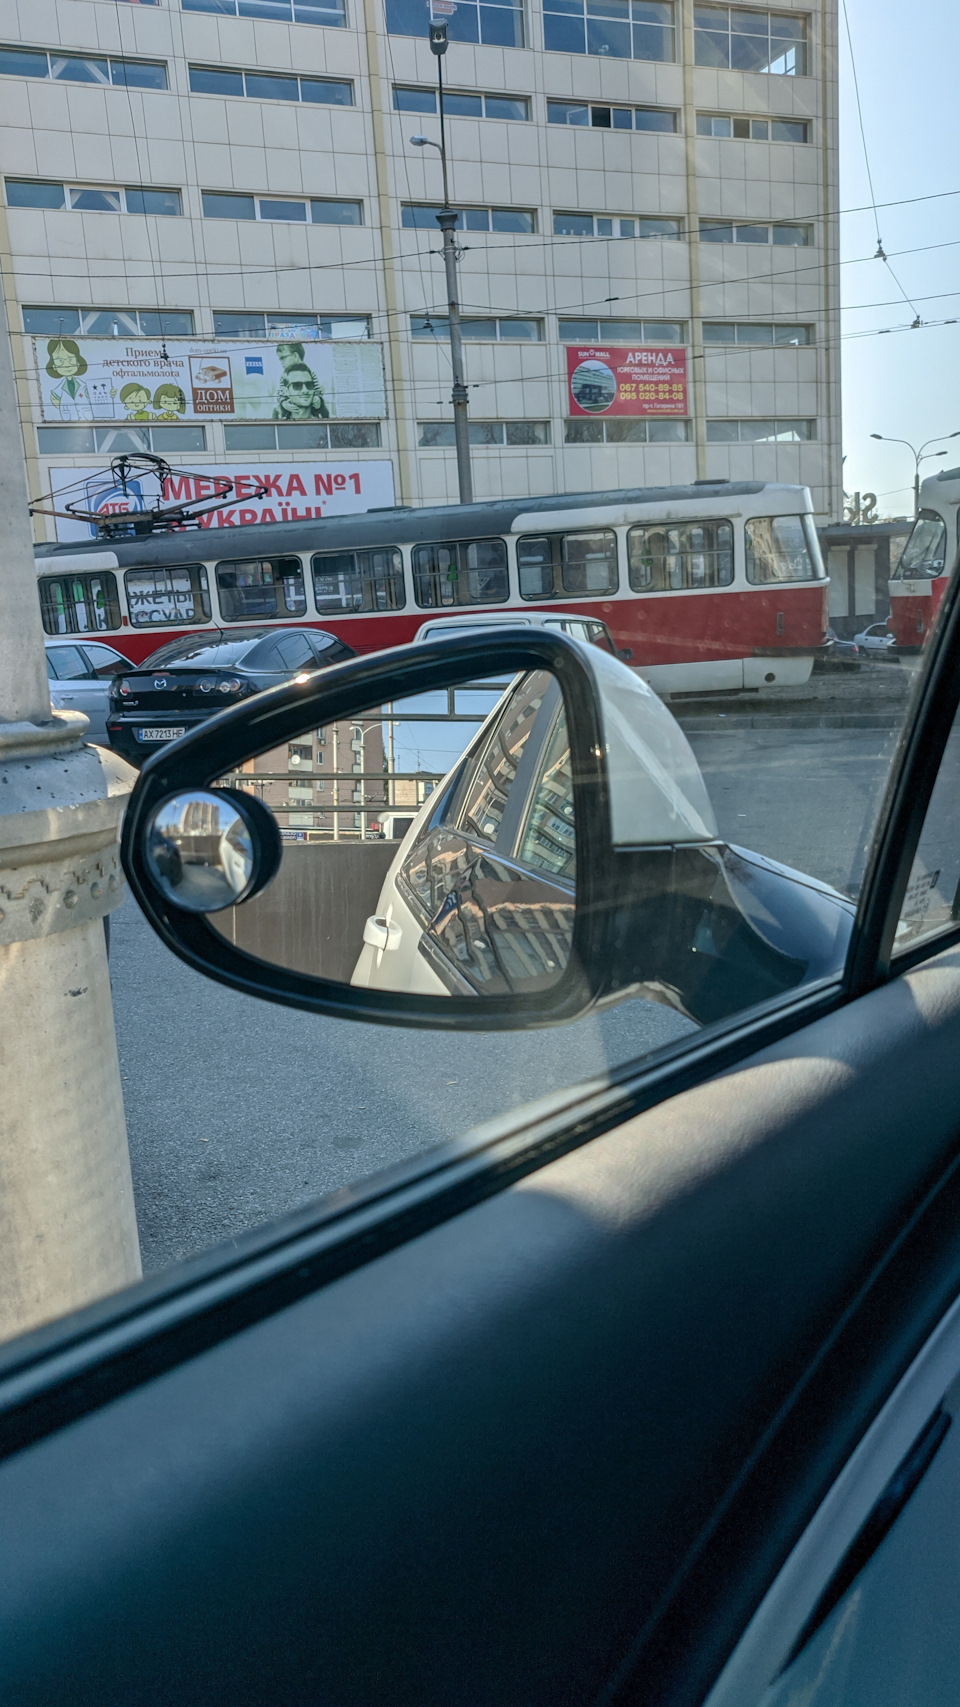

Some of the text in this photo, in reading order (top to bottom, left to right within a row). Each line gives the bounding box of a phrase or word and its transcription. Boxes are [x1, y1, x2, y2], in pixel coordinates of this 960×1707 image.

[125, 347, 162, 359] Прием
[102, 358, 185, 369] детского врача
[625, 352, 675, 366] АРЕНДА
[112, 367, 181, 378] офтальмолога
[616, 366, 648, 374] ТОРГОВЫХ
[631, 373, 671, 381] ПОМЕЩЕНИЙ
[619, 383, 683, 392] 067 540-89-85
[196, 390, 230, 403] ДОМ
[620, 392, 684, 400] 095 020-84-08
[162, 473, 308, 501] МЕРЕЖА
[98, 502, 129, 515] АТБ
